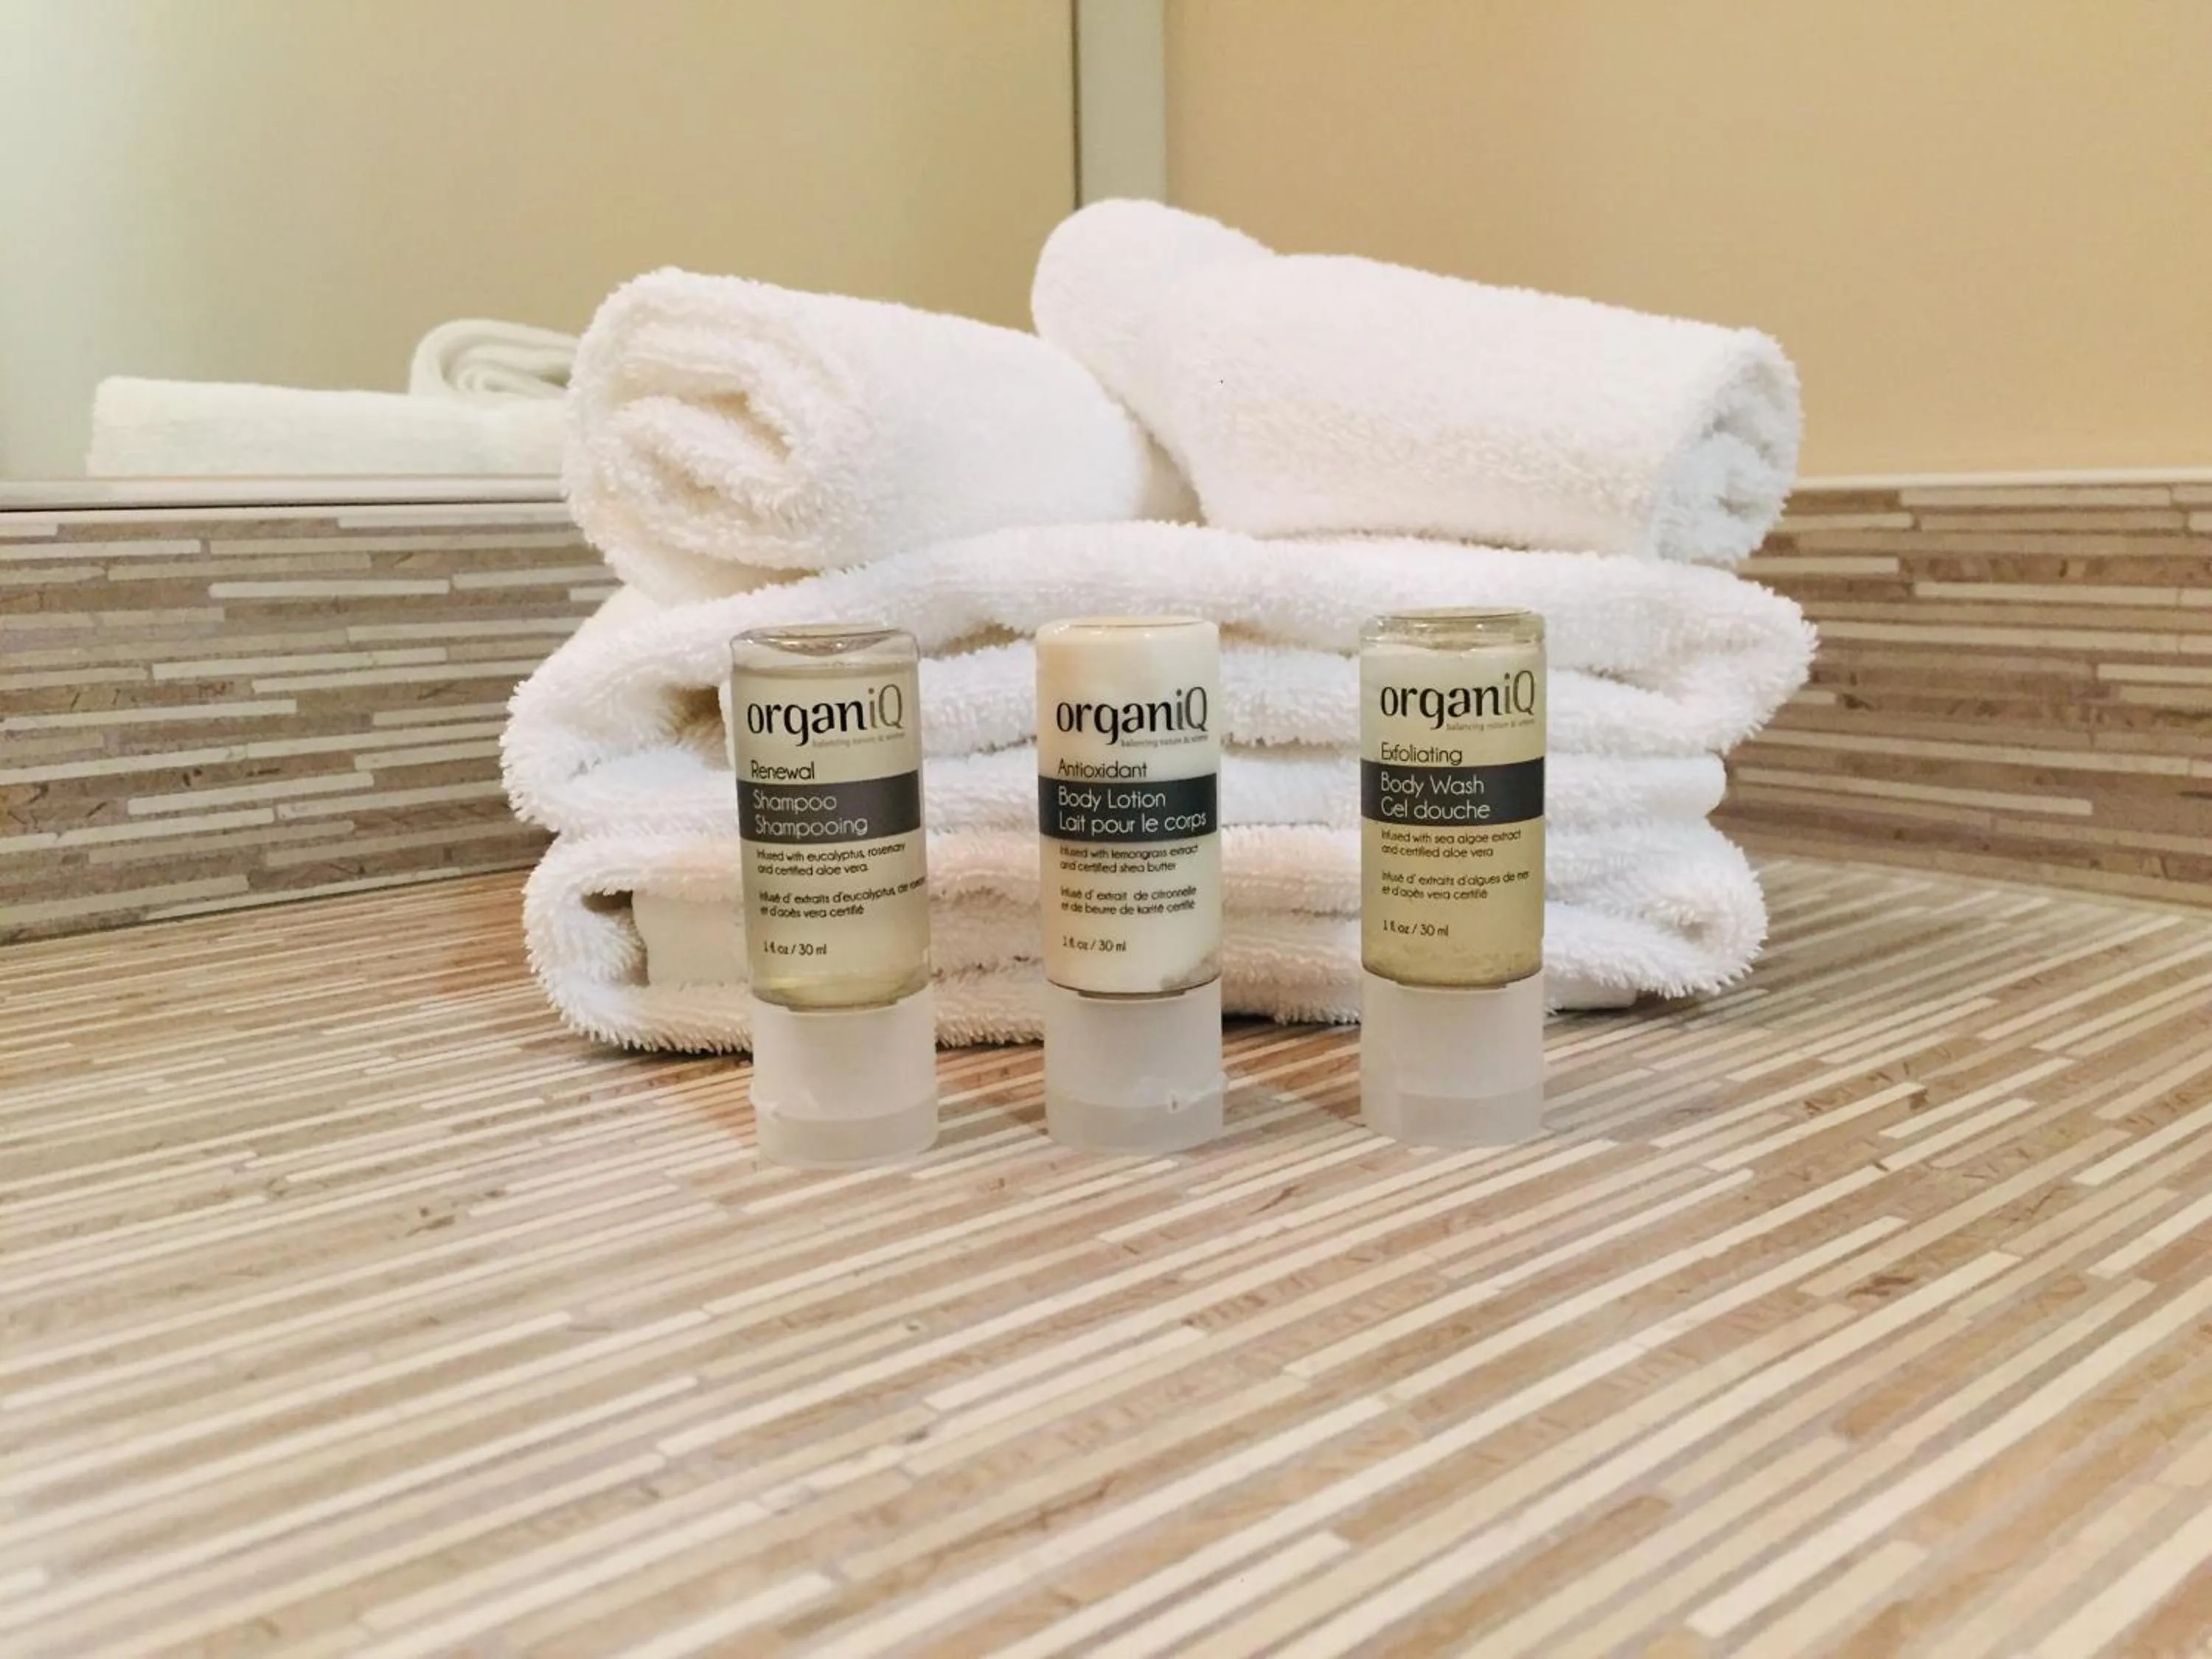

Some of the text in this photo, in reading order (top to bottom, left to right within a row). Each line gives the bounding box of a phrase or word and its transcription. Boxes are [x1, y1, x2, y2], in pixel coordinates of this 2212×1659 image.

[1380, 669, 1534, 730] organiQ
[747, 684, 904, 747] organiQ
[1056, 686, 1208, 745] organiQ
[1381, 741, 1463, 765] Exfoliating
[751, 759, 815, 779] Renewal
[1057, 757, 1147, 779] Antioxidant
[1381, 771, 1484, 798] Body Wash
[753, 789, 837, 814] Shampoo
[1057, 785, 1166, 812] Body Lotion
[1413, 799, 1491, 819] douche
[755, 814, 868, 839] Shampooing
[1060, 812, 1206, 835] Lait pour le corps
[1382, 829, 1521, 846] Infused with sea algae extract
[757, 849, 784, 862] Infused
[786, 851, 804, 862] with
[867, 843, 905, 857] rosemary
[1060, 844, 1198, 860] Infused with lemongrass extract
[1382, 844, 1493, 858] and certified aloe vera
[757, 864, 773, 874] and
[775, 863, 813, 876] certified
[815, 863, 841, 875] aloe
[1060, 860, 1177, 873] and certified shea butter
[1419, 874, 1454, 886] extraits
[1503, 872, 1515, 883] de
[794, 893, 829, 904] extraits
[1096, 891, 1127, 901] extrait
[1133, 888, 1148, 901] de
[1427, 889, 1450, 900] vera
[1453, 887, 1488, 900] certifié
[803, 908, 827, 918] vera
[829, 904, 864, 917] certifié
[1070, 902, 1082, 913] de
[1085, 903, 1116, 915] beurre
[1119, 903, 1134, 915] de
[1397, 924, 1410, 934] oz
[1420, 923, 1436, 936] 30
[1437, 925, 1449, 936] ml
[776, 945, 789, 955] oz
[799, 943, 813, 956] 30
[815, 943, 827, 955] ml
[1077, 939, 1088, 950] oz
[1099, 939, 1113, 951] 30
[1116, 940, 1127, 952] ml
